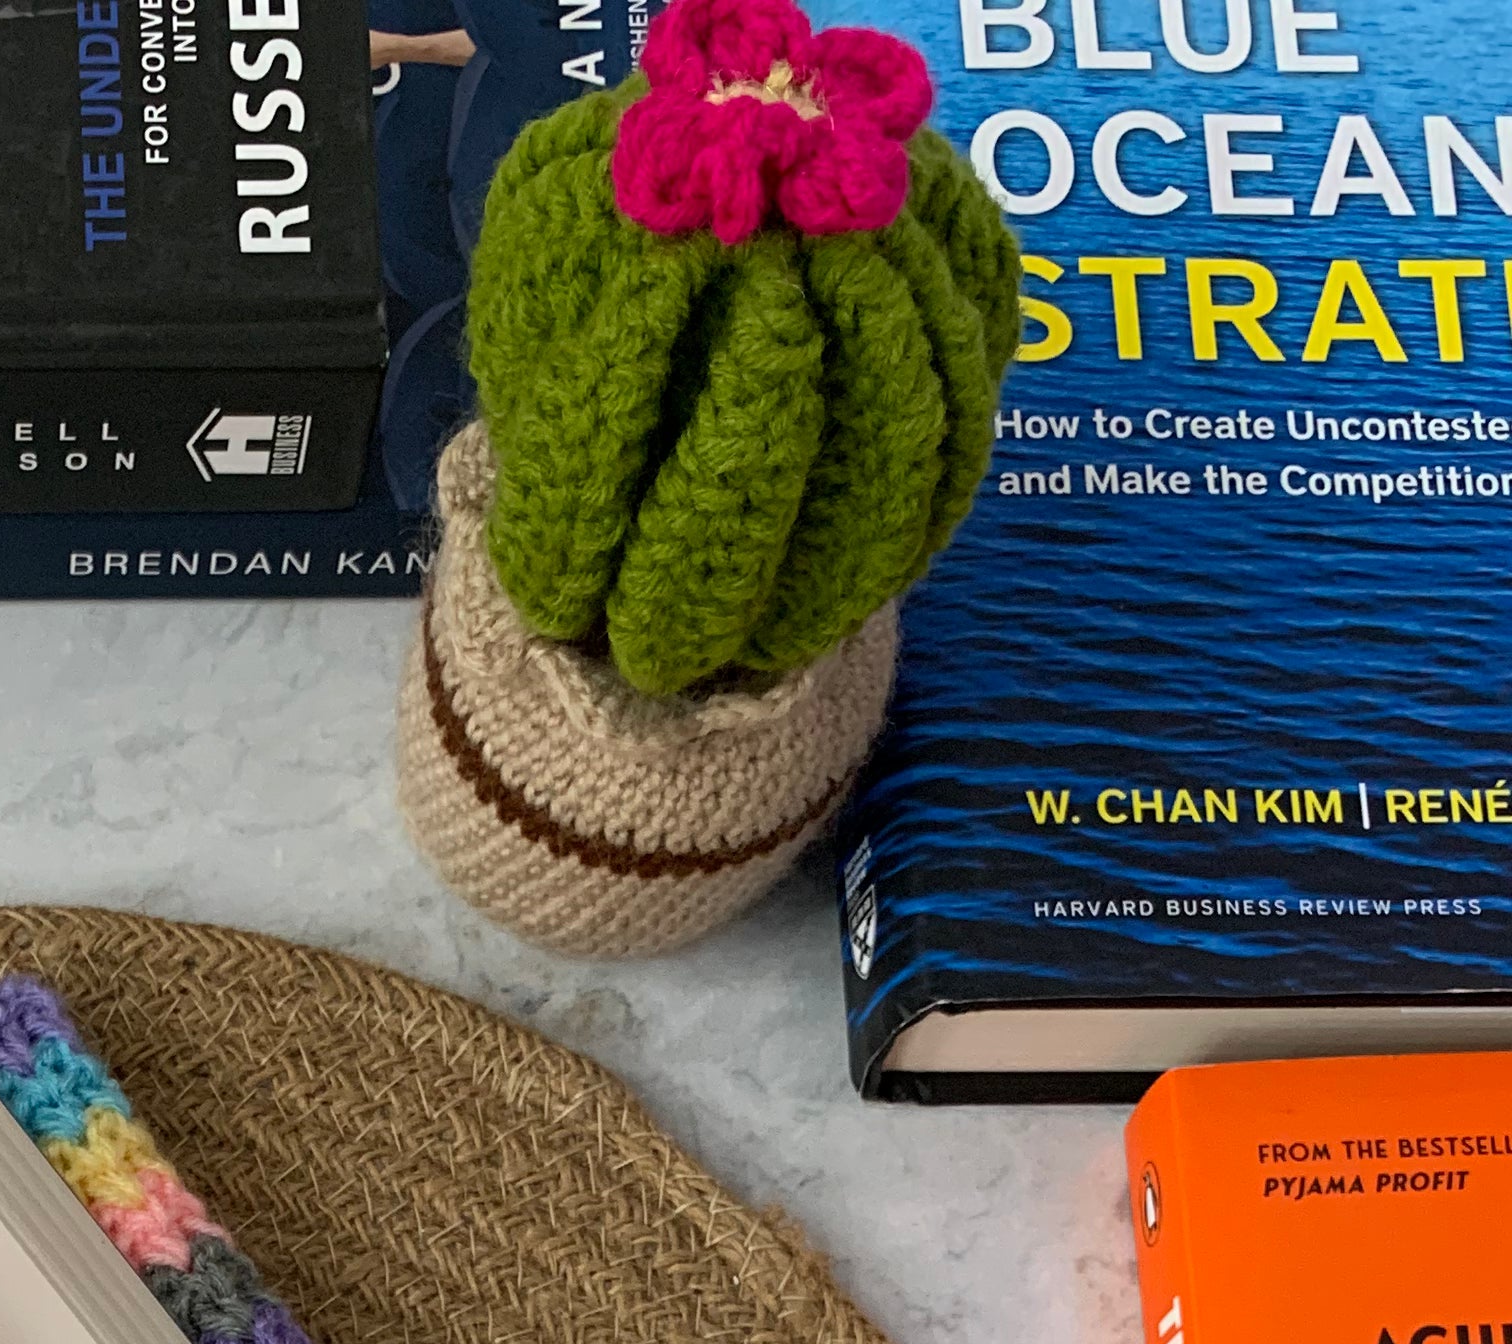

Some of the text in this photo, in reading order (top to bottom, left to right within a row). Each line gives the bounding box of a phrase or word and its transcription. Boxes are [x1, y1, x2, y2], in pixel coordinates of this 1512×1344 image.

[964, 0, 1360, 73] BLUE
[77, 0, 127, 250] THE UNDE
[144, 103, 169, 163] FOR
[228, 0, 312, 254] RUSSE
[968, 110, 1512, 218] OCEAN
[1016, 256, 1512, 364] STRAT
[270, 414, 304, 475] BUSINESS
[994, 409, 1080, 440] How
[1093, 411, 1133, 440] to
[1144, 408, 1276, 441] Create
[998, 465, 1071, 495] and
[1084, 464, 1191, 495] Make
[1204, 465, 1269, 496] the
[70, 551, 436, 577] BRENDAN KAN
[1025, 780, 1512, 824] W. CHAN KIM RENÉ
[1033, 899, 1483, 918] HARVARD BUSINESS REVIEW PRESS
[1258, 1143, 1331, 1164] FROM
[1342, 1138, 1388, 1161] THE
[1263, 1169, 1470, 1199] PYJAMA PROFIT
